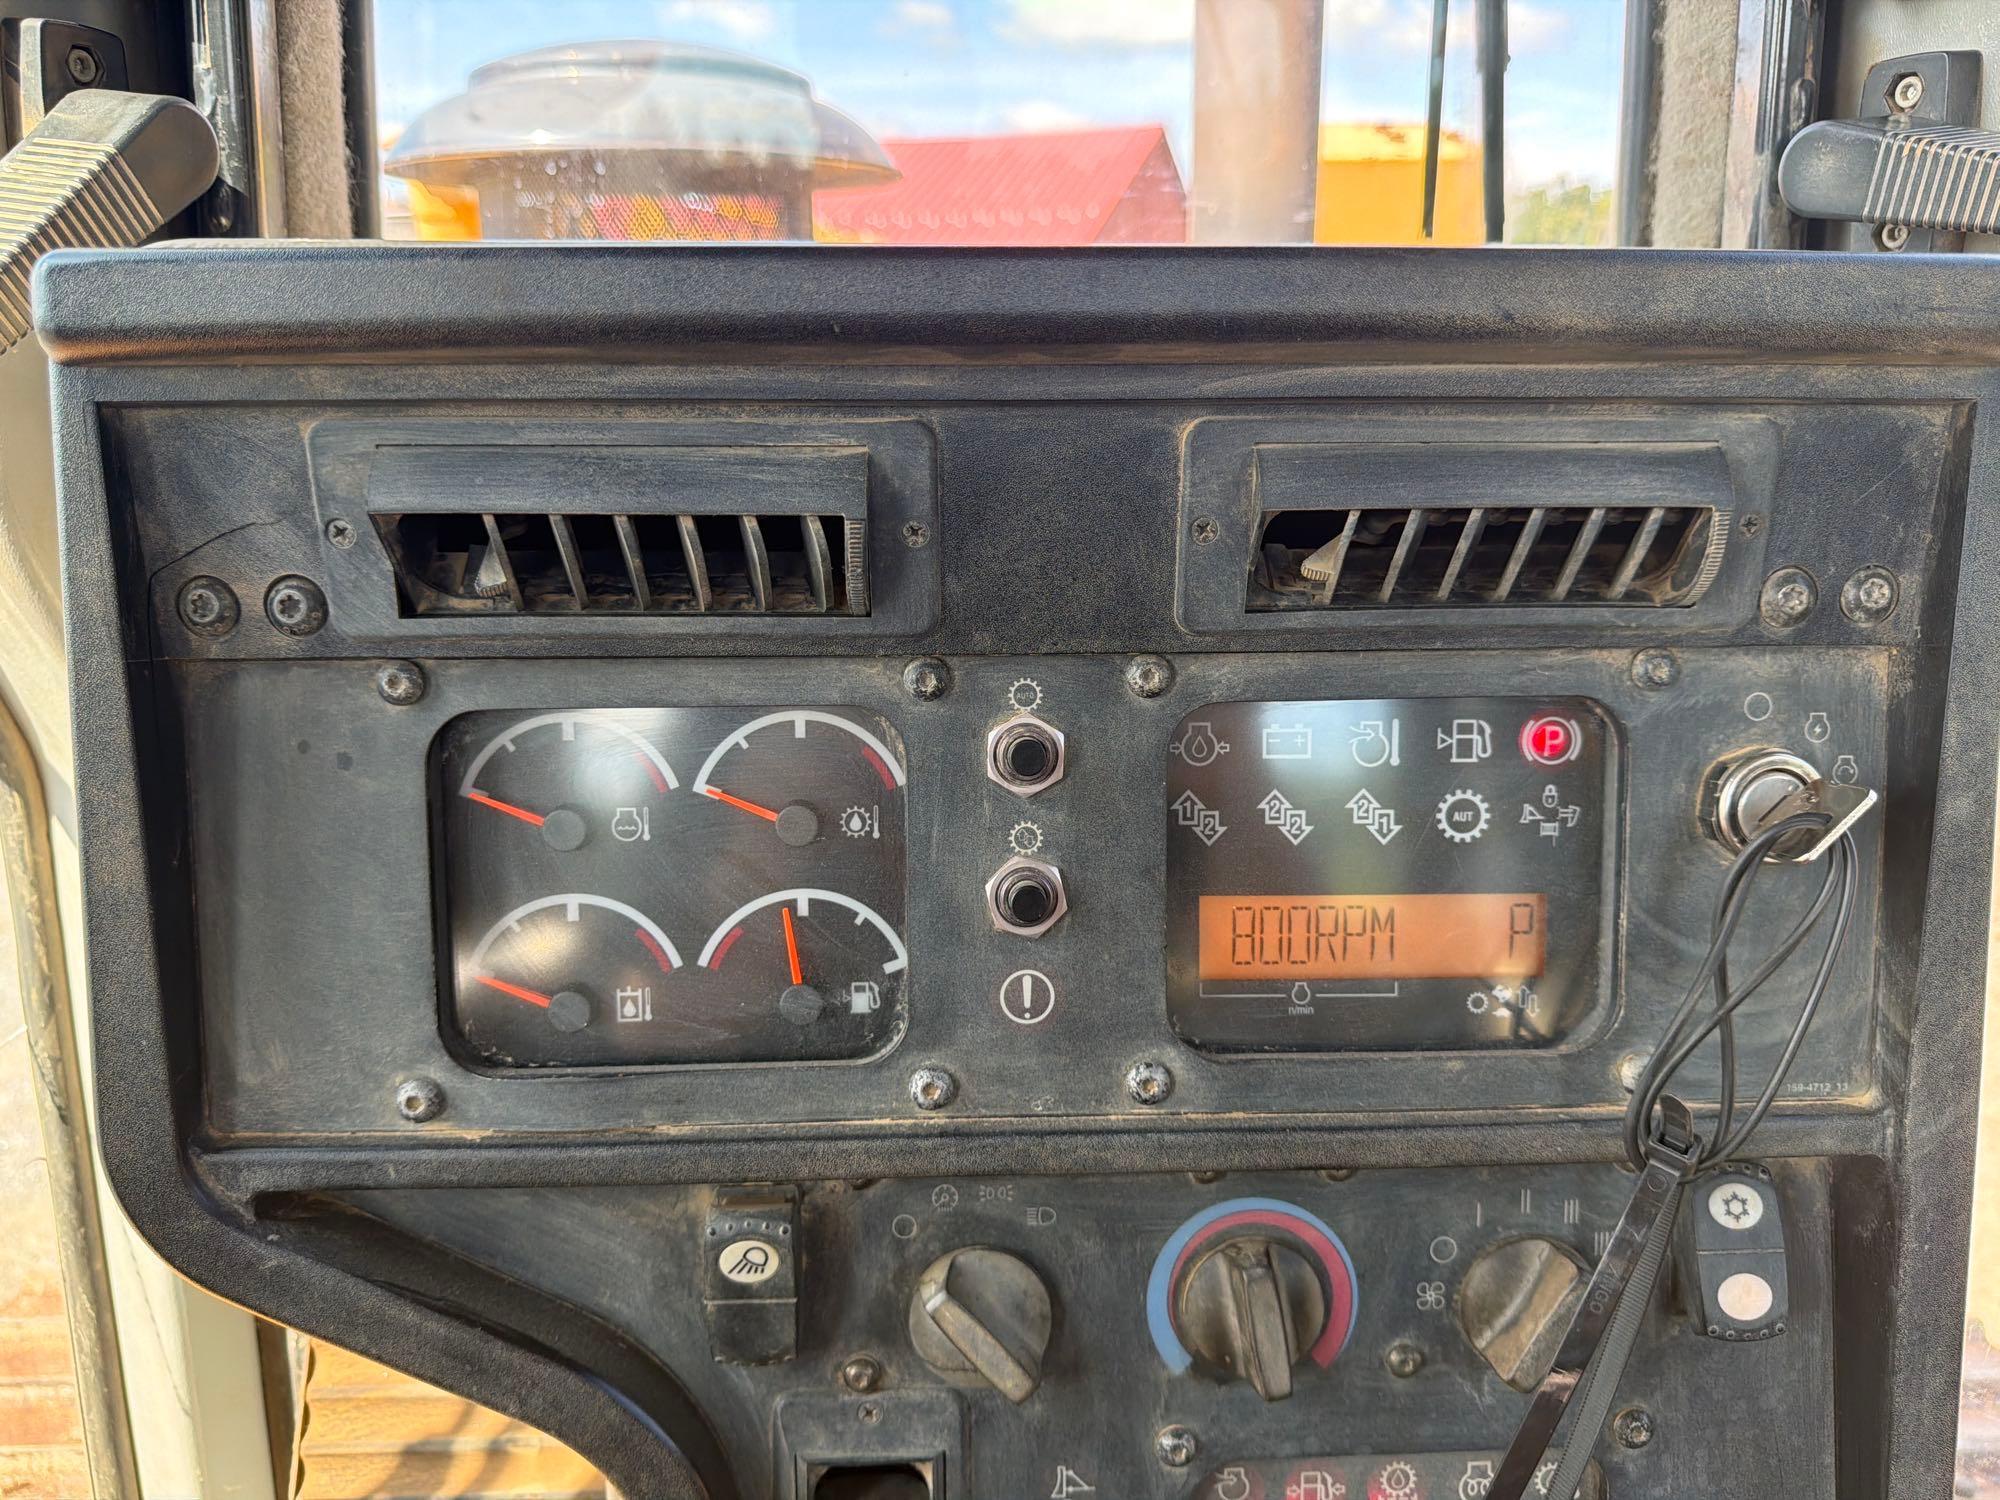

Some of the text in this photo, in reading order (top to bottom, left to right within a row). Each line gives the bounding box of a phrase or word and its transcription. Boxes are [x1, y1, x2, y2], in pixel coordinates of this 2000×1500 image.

[1543, 725, 1565, 757] P
[1183, 801, 1192, 818] 1
[1269, 799, 1281, 818] 2
[1357, 799, 1369, 818] 2
[1452, 810, 1474, 822] AUT
[1203, 817, 1215, 836] 2
[1290, 816, 1302, 835] 2
[1379, 815, 1389, 834] 1
[1232, 903, 1534, 966] 800RPM P
